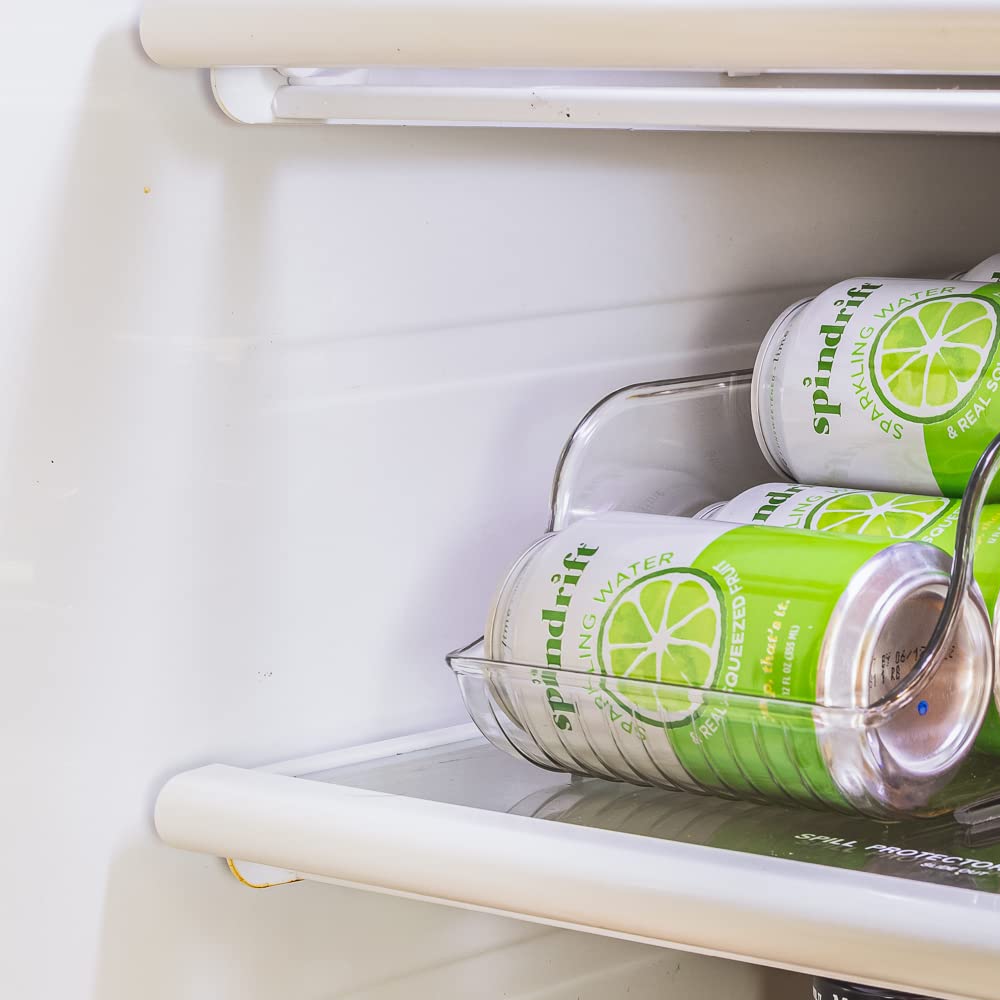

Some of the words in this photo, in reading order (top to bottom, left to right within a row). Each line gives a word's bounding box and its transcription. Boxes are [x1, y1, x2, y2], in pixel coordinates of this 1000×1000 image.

[873, 286, 957, 319] WATER
[773, 330, 790, 362] lime
[803, 282, 883, 435] spindrift
[850, 326, 904, 440] SPARKLING
[946, 425, 958, 440] &
[957, 396, 992, 432] REAL
[922, 507, 960, 543] SQUE
[593, 552, 674, 603] WATER
[712, 560, 743, 595] FRUIT
[760, 621, 782, 673] that's
[774, 600, 791, 617] it.
[782, 676, 792, 686] FL
[784, 662, 793, 674] OZ
[782, 687, 791, 696] 12
[700, 706, 727, 736] REAL
[794, 833, 858, 848] SPILL
